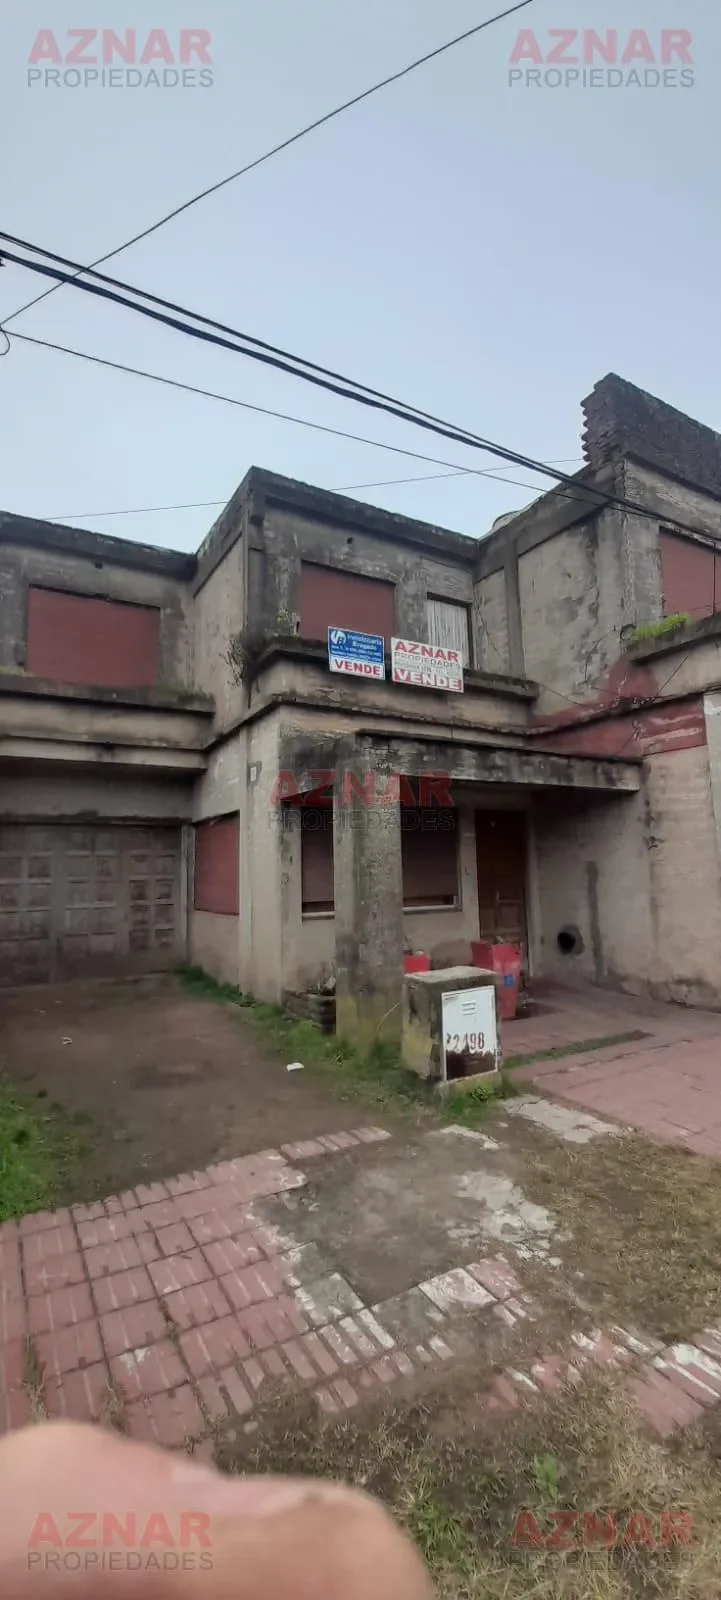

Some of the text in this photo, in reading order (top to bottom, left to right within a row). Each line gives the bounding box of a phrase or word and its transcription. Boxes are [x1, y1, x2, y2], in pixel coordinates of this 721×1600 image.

[395, 640, 458, 662] AZNAR
[395, 652, 460, 668] PROPIEDADES
[335, 659, 381, 676] VENDE
[395, 668, 460, 690] VENDE
